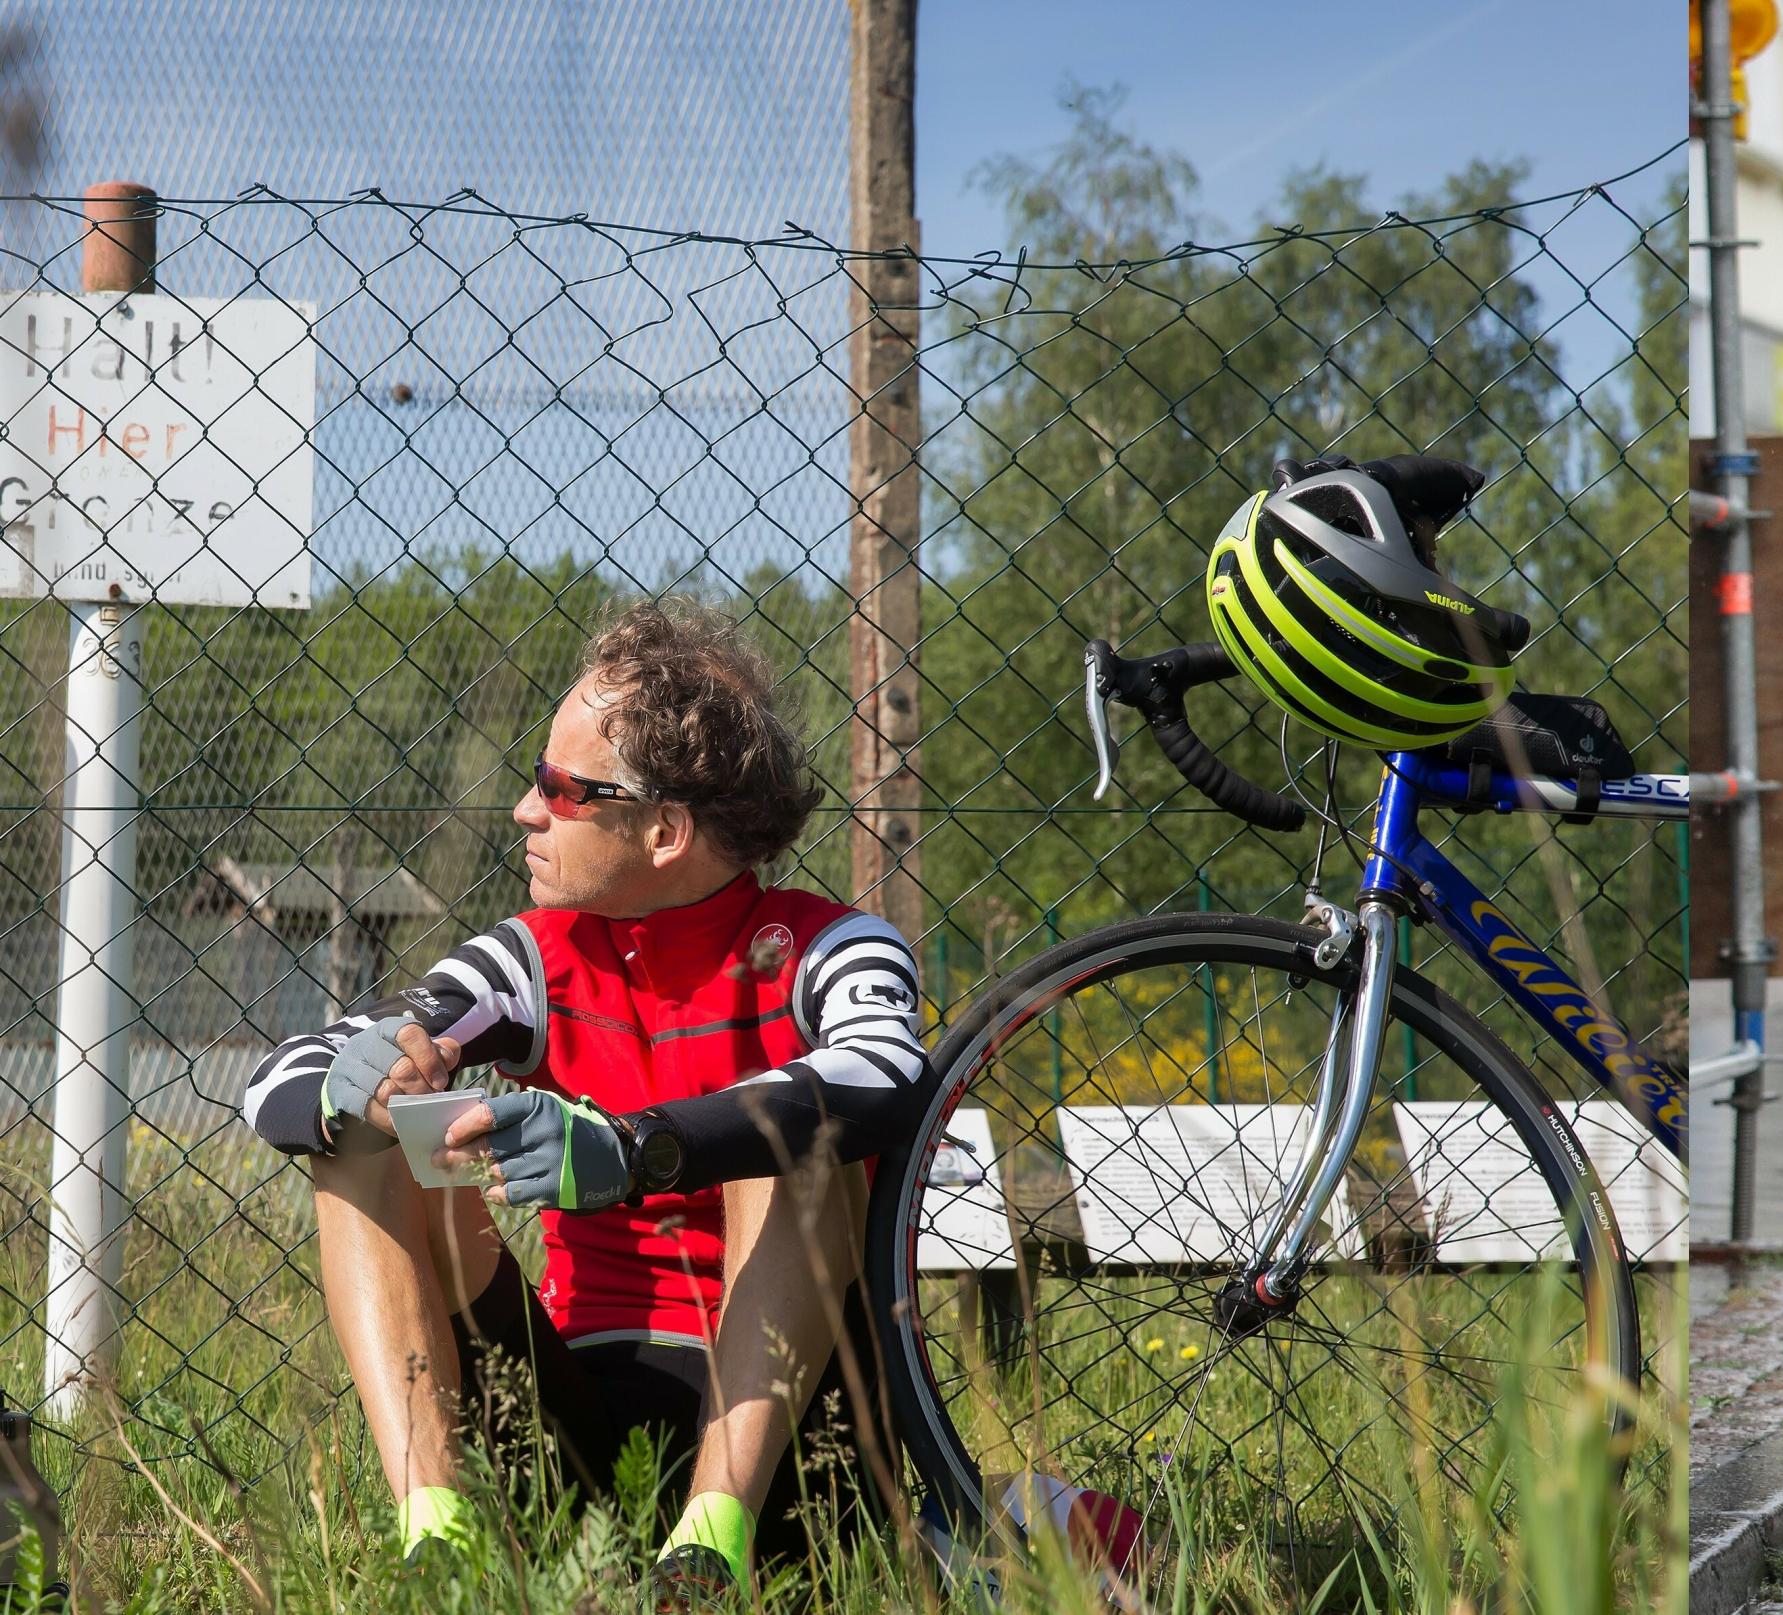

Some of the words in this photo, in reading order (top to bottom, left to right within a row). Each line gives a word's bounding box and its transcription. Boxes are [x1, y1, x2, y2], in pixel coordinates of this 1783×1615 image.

[26, 313, 216, 385] Halt!
[47, 403, 188, 460] Hier
[1423, 590, 1476, 615] ALPINA
[1601, 776, 1689, 797] ESC
[1547, 1114, 1588, 1177] HUTCHINSON
[1589, 1191, 1611, 1231] FUSION
